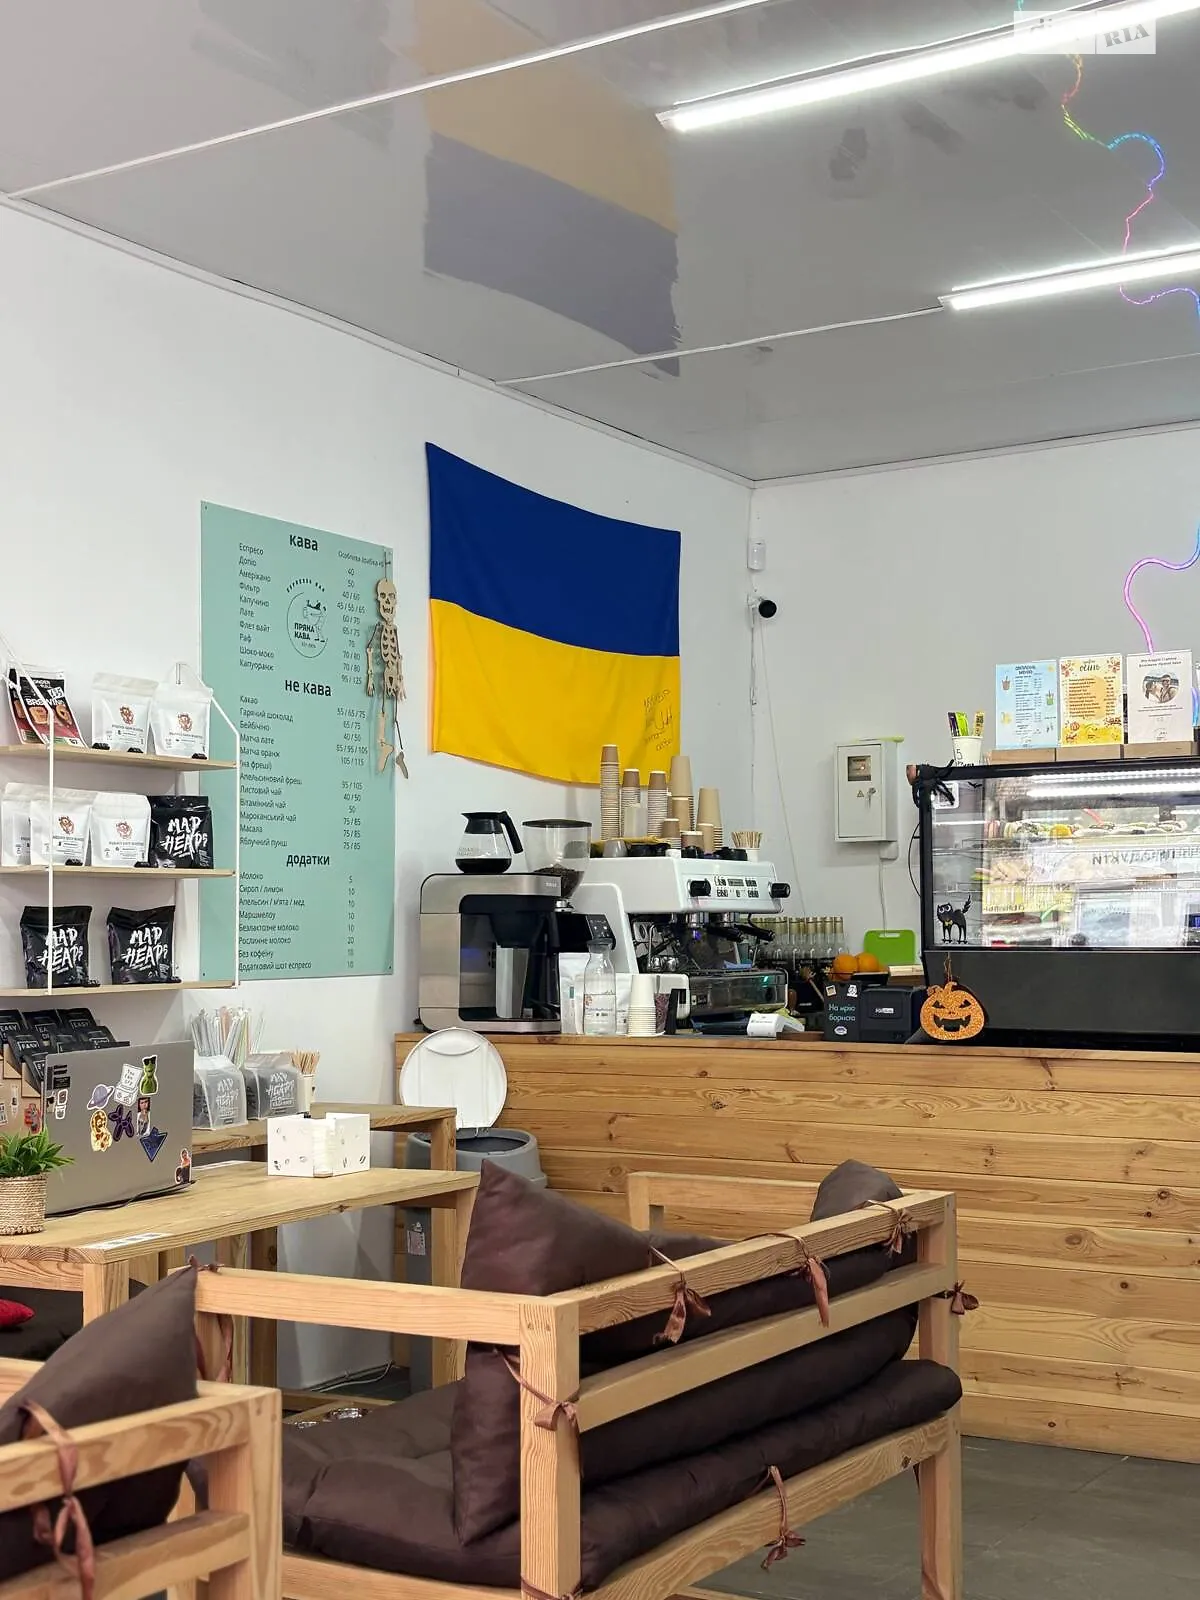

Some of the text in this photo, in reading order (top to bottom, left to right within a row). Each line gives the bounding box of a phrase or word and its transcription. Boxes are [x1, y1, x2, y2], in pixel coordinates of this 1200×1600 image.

[290, 534, 318, 551] кава
[240, 543, 263, 555] Еспресо
[239, 569, 271, 582] Американо
[240, 594, 269, 607] Капучино
[240, 607, 255, 617] Лате
[295, 622, 314, 633] ПРЯНА
[295, 631, 311, 641] КАВА
[285, 680, 331, 697] не кава
[240, 696, 258, 705] Какао
[240, 708, 294, 723] Гарячий шоколад
[240, 734, 274, 744] Матча лате
[240, 747, 259, 755] Матча
[240, 772, 284, 784] Апельсиновий
[240, 785, 269, 794] Листовий
[286, 814, 297, 822] чай
[168, 816, 201, 834] MAD
[240, 824, 263, 833] Масала
[160, 832, 208, 857] HEADS
[286, 854, 330, 868] додатки
[239, 884, 259, 895] Сироп
[239, 898, 269, 906] Апельсин
[294, 900, 305, 908] мед
[130, 924, 162, 944] MAD
[121, 942, 168, 969] HEADS
[238, 962, 274, 972] Додатковий
[288, 961, 312, 970] еспресо
